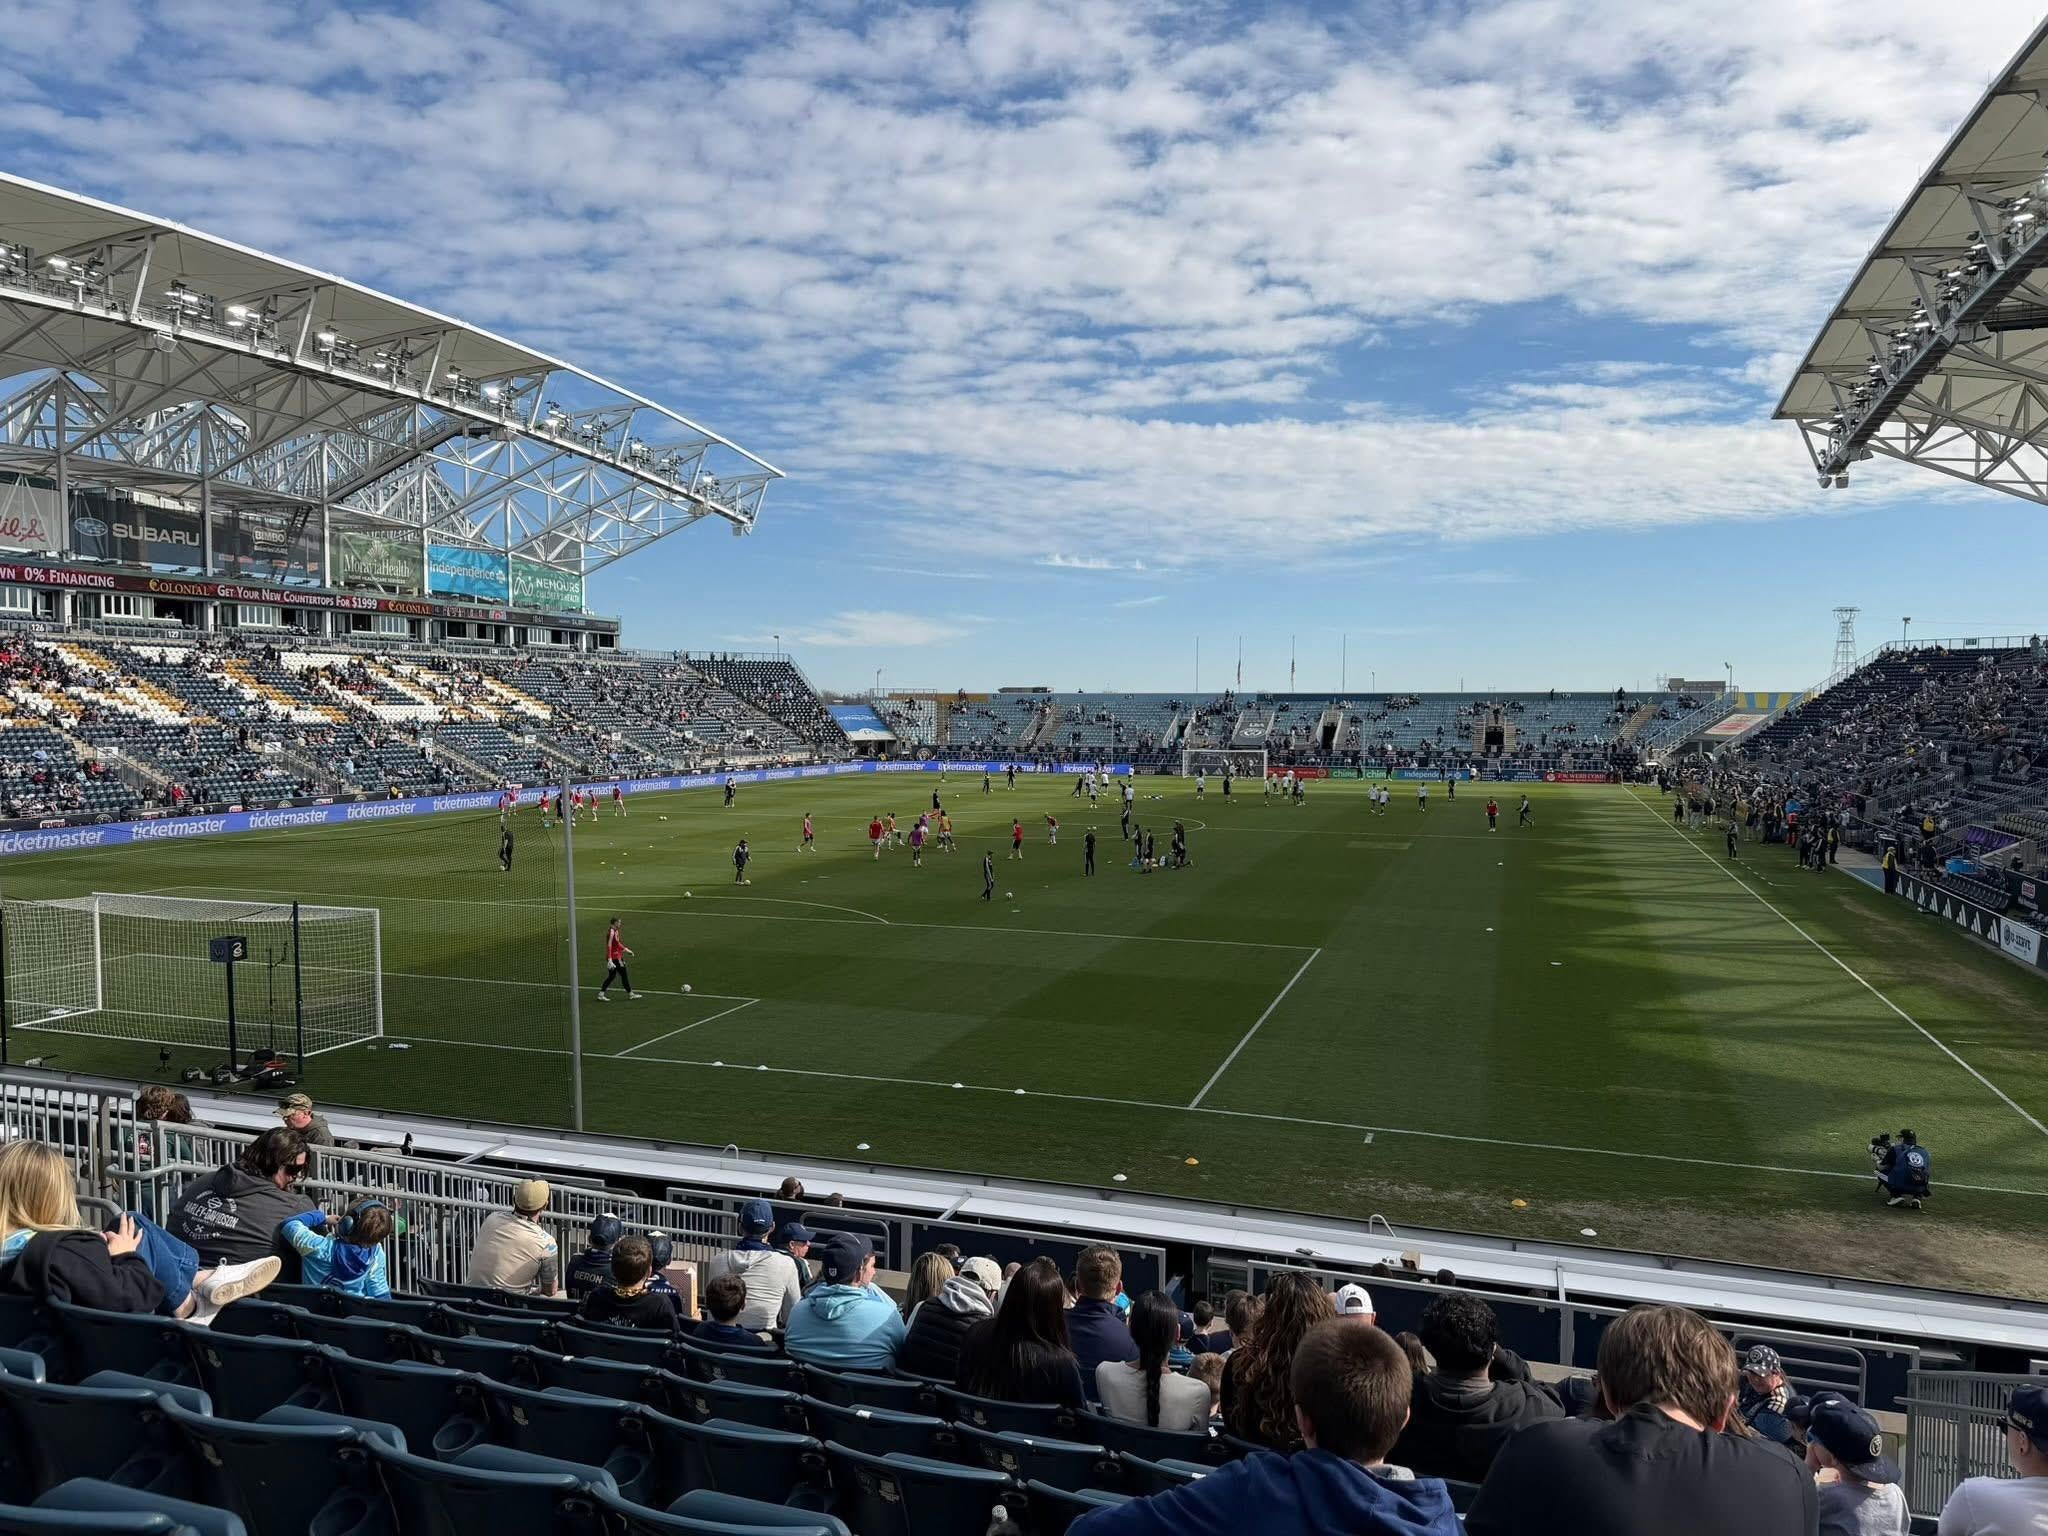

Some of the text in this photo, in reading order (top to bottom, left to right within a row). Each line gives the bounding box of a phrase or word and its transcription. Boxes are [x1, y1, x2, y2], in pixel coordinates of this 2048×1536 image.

[112, 523, 200, 547] SUBARU
[254, 530, 285, 543] BIMBO
[24, 567, 45, 582] 0%
[49, 569, 115, 589] FINANCING
[430, 560, 494, 580] Independence
[149, 579, 210, 596] COLONIAL
[536, 577, 580, 593] NEMOURS
[352, 597, 377, 609] $1999
[388, 600, 432, 614] COLONIAL
[31, 623, 45, 632] 126
[168, 630, 179, 638] 127
[876, 762, 925, 771] ticketmaster
[346, 801, 416, 819] ticketmaster
[433, 795, 494, 811] ticketmaster
[249, 810, 328, 828] ticketmaster
[132, 818, 226, 840] ticketmaster
